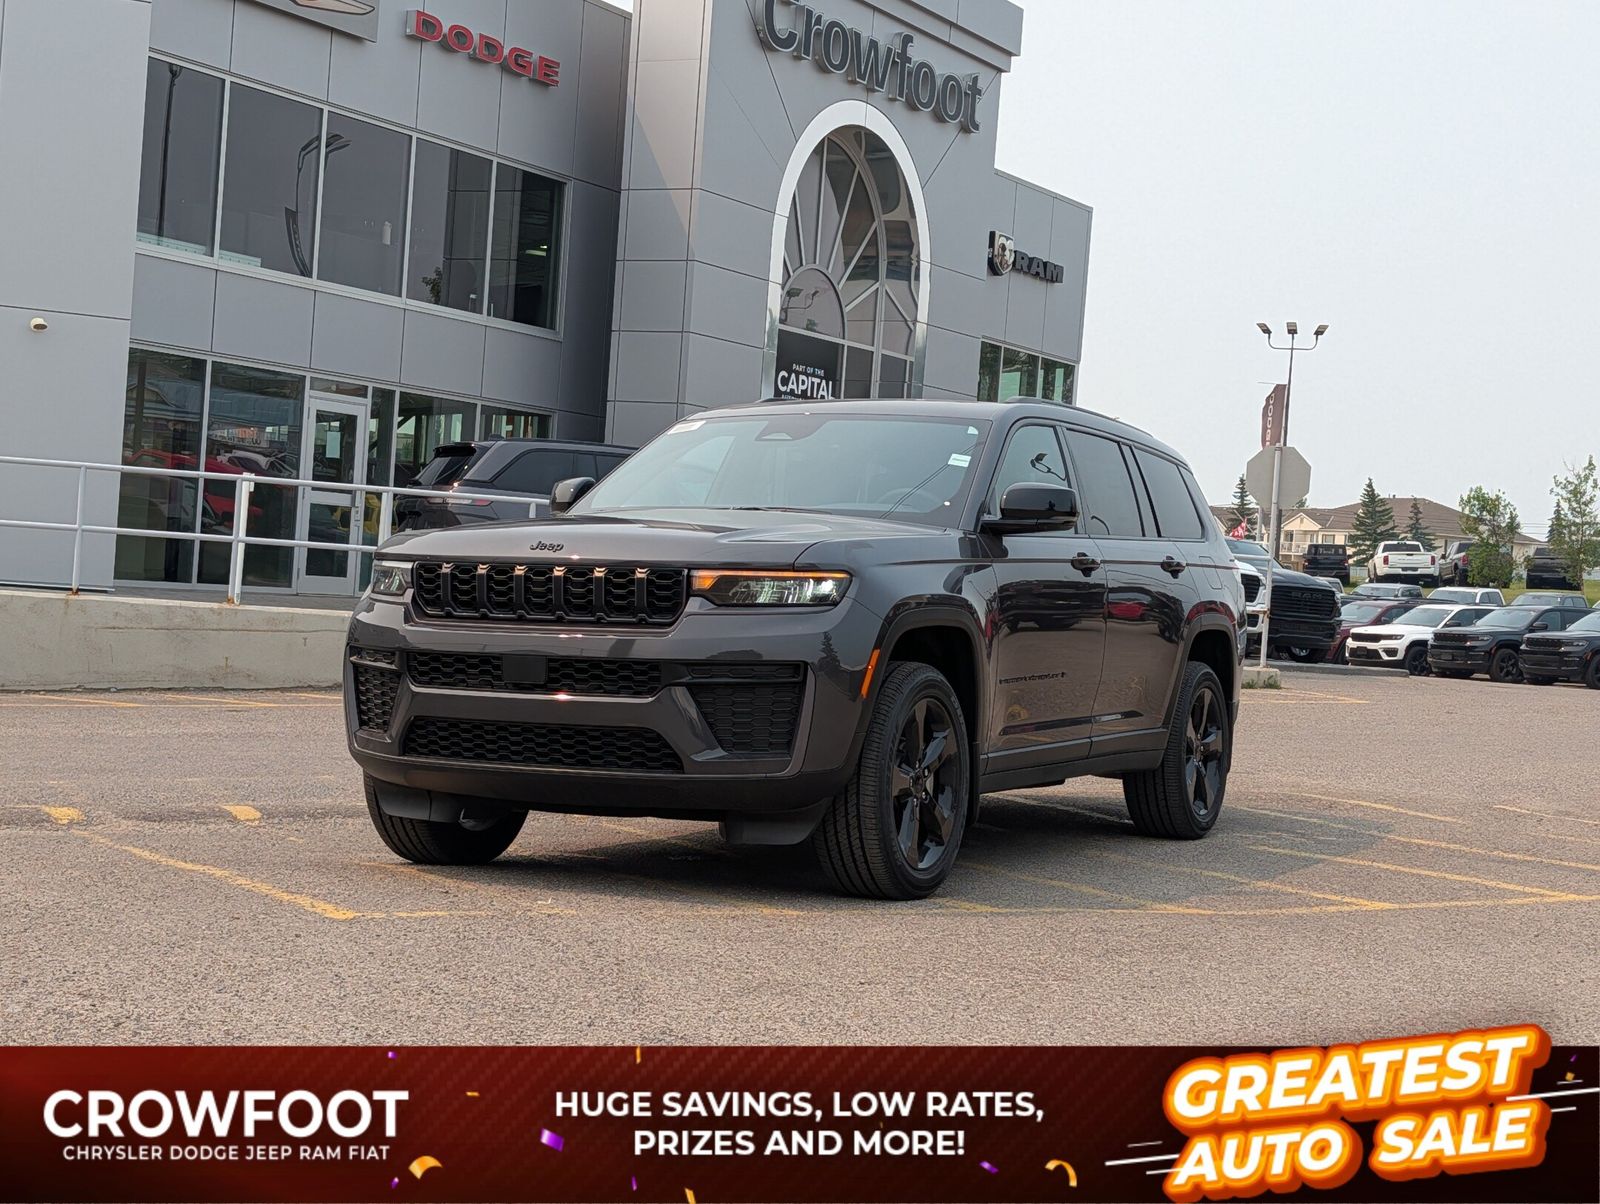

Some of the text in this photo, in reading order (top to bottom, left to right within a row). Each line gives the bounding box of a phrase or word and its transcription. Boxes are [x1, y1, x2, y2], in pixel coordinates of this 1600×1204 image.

[414, 9, 561, 87] DODGE
[760, 0, 984, 133] Crowfoot
[1014, 250, 1064, 283] RAM
[777, 370, 836, 400] CAPITAL
[792, 363, 825, 377] PART OF THE
[529, 540, 564, 553] Jeep
